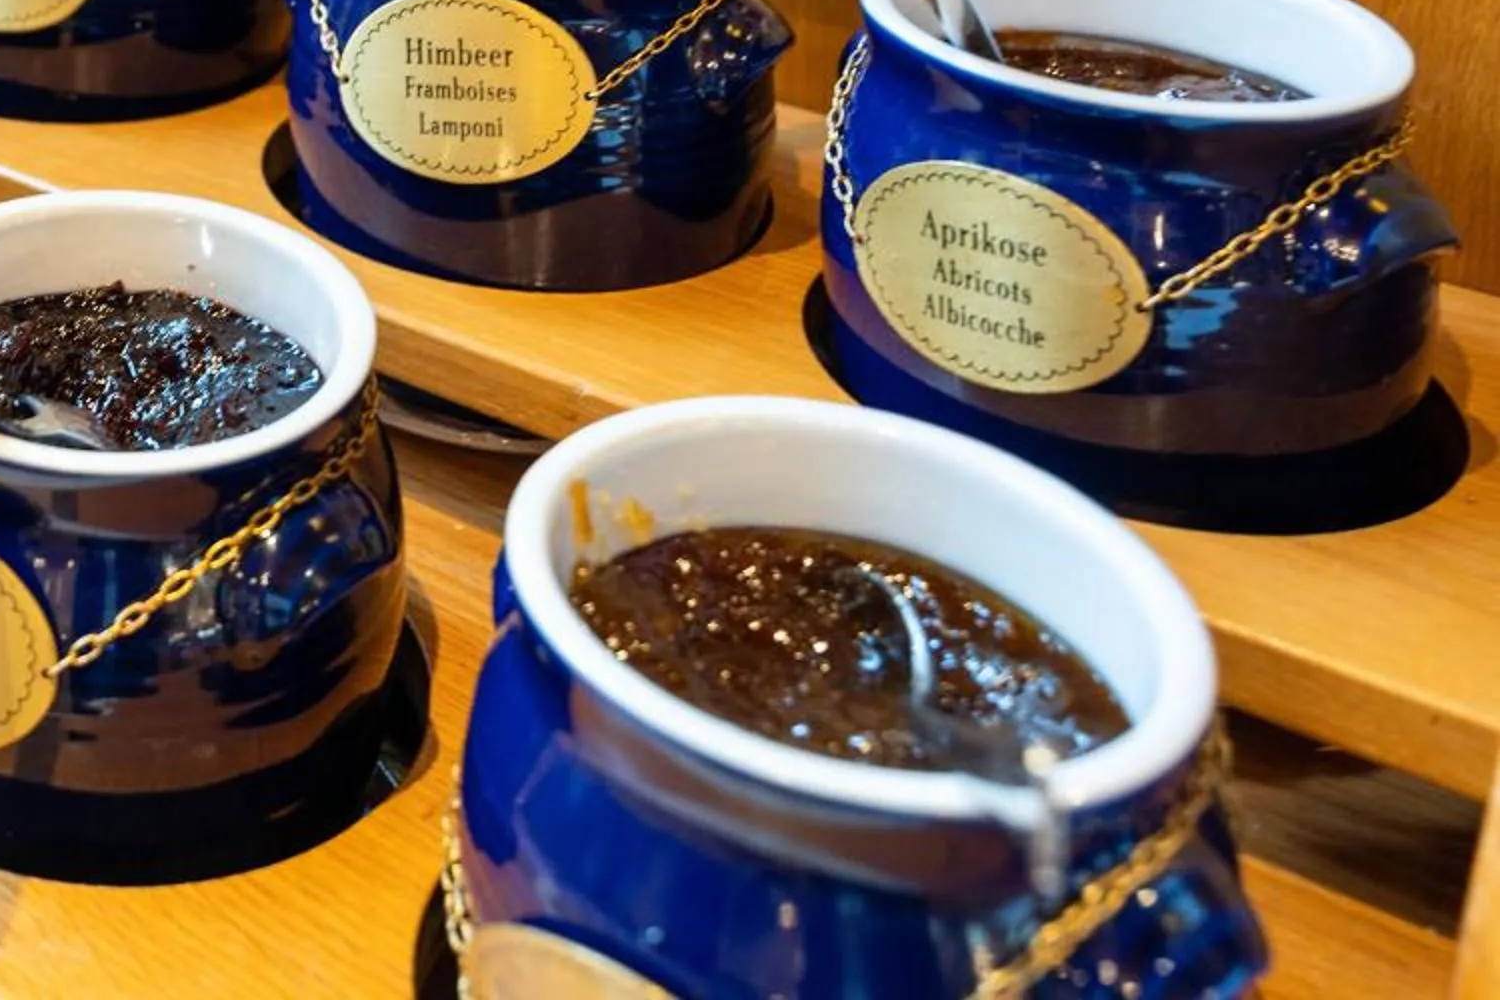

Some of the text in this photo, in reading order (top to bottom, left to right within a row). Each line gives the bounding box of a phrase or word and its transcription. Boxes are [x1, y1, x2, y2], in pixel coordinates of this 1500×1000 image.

[405, 38, 515, 68] Himbeer
[404, 76, 517, 102] Framboises
[419, 112, 504, 142] Lamponi
[919, 209, 1049, 267] Aprikose
[932, 258, 1033, 305] Abricots
[922, 294, 1047, 349] Albicocche
